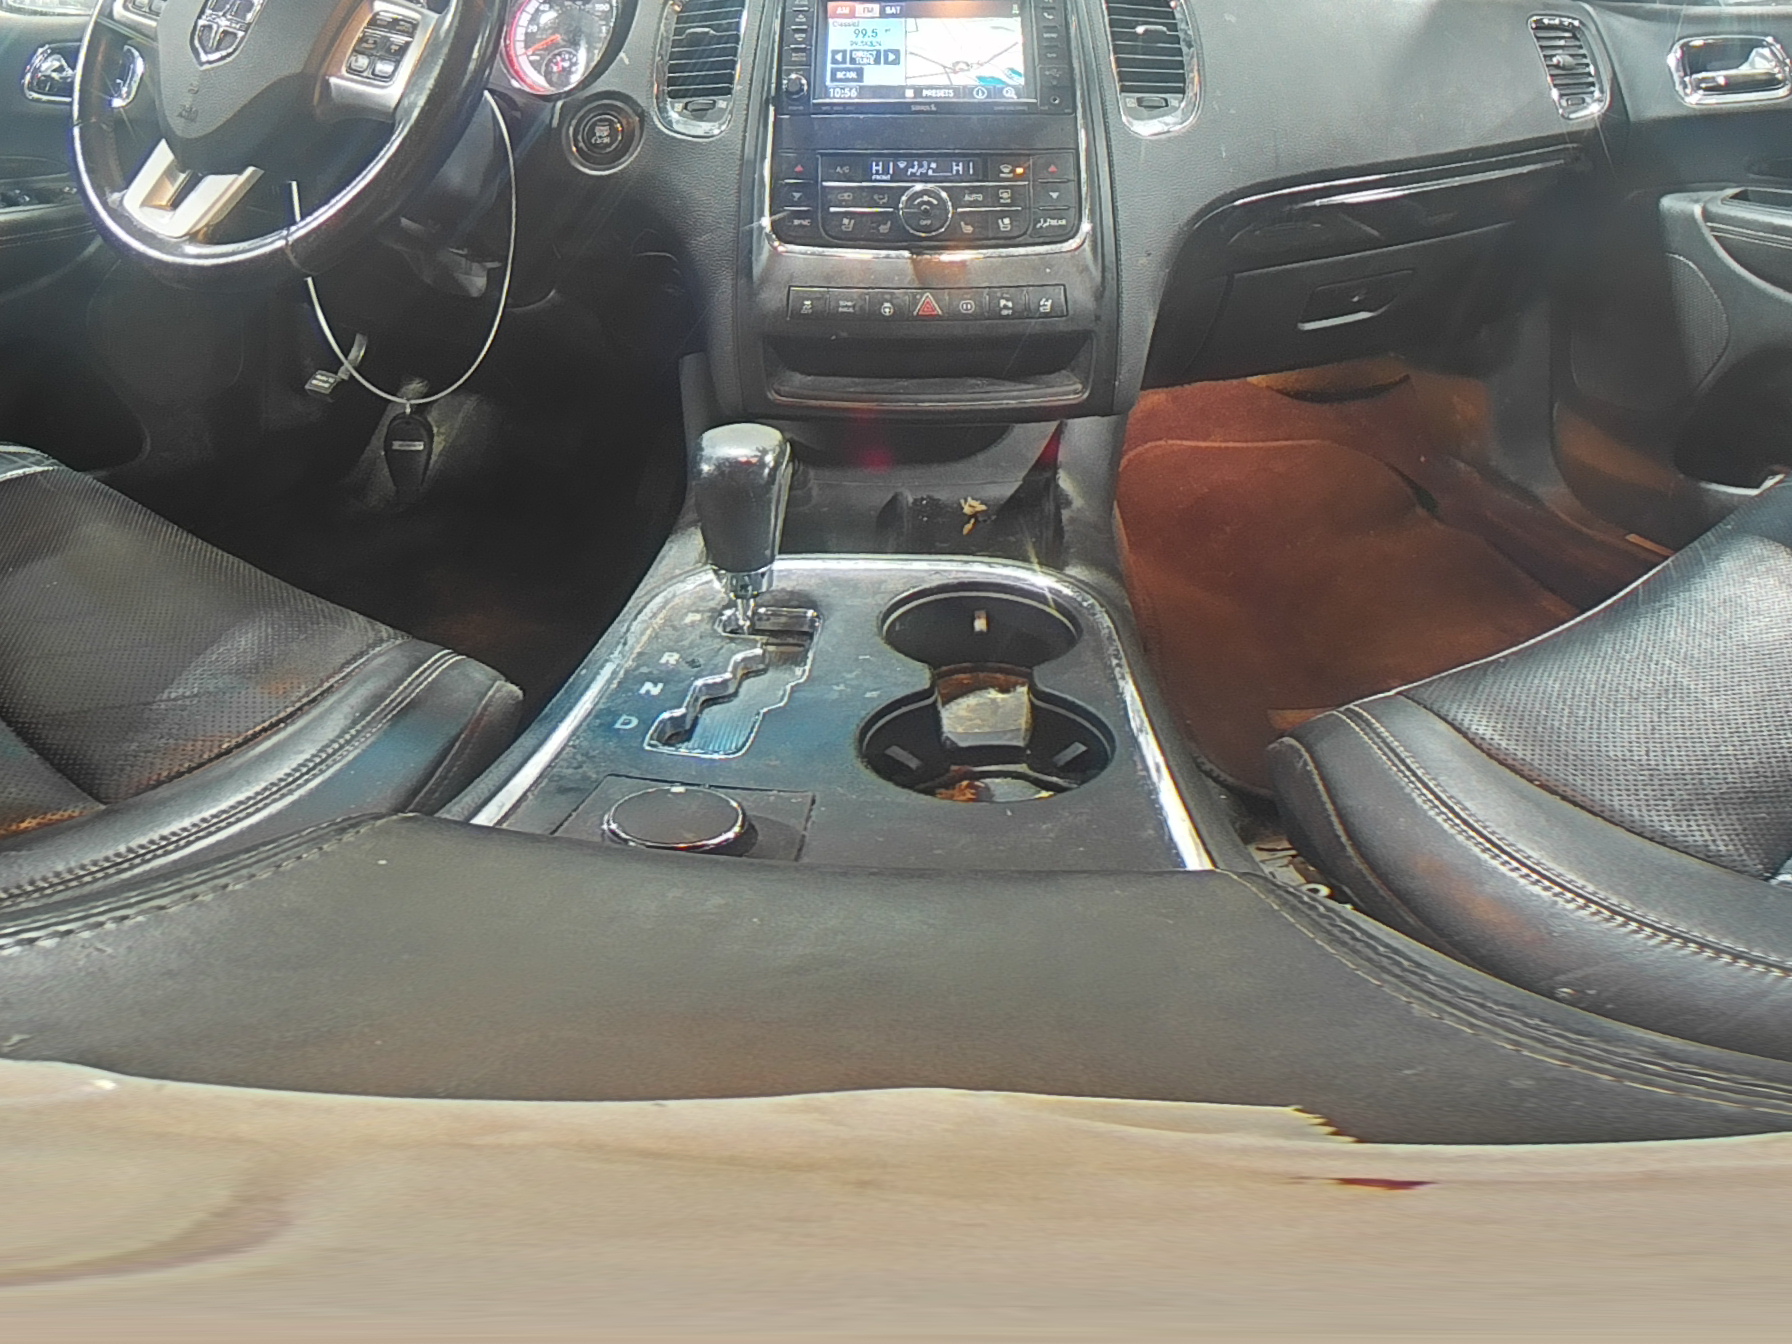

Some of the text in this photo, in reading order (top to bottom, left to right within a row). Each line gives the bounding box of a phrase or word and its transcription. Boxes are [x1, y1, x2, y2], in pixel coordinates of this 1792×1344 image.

[836, 6, 850, 14] AM
[885, 6, 901, 15] SAT
[853, 28, 878, 39] 99.5
[855, 57, 875, 65] TUNE
[836, 71, 857, 79] SCAN
[829, 87, 858, 98] 10:56
[922, 88, 954, 97] PRESETS
[836, 165, 850, 174] A/C
[964, 193, 983, 202] AUTO
[684, 612, 702, 625] P
[658, 651, 681, 665] R
[638, 681, 664, 696] N
[613, 714, 639, 729] D
